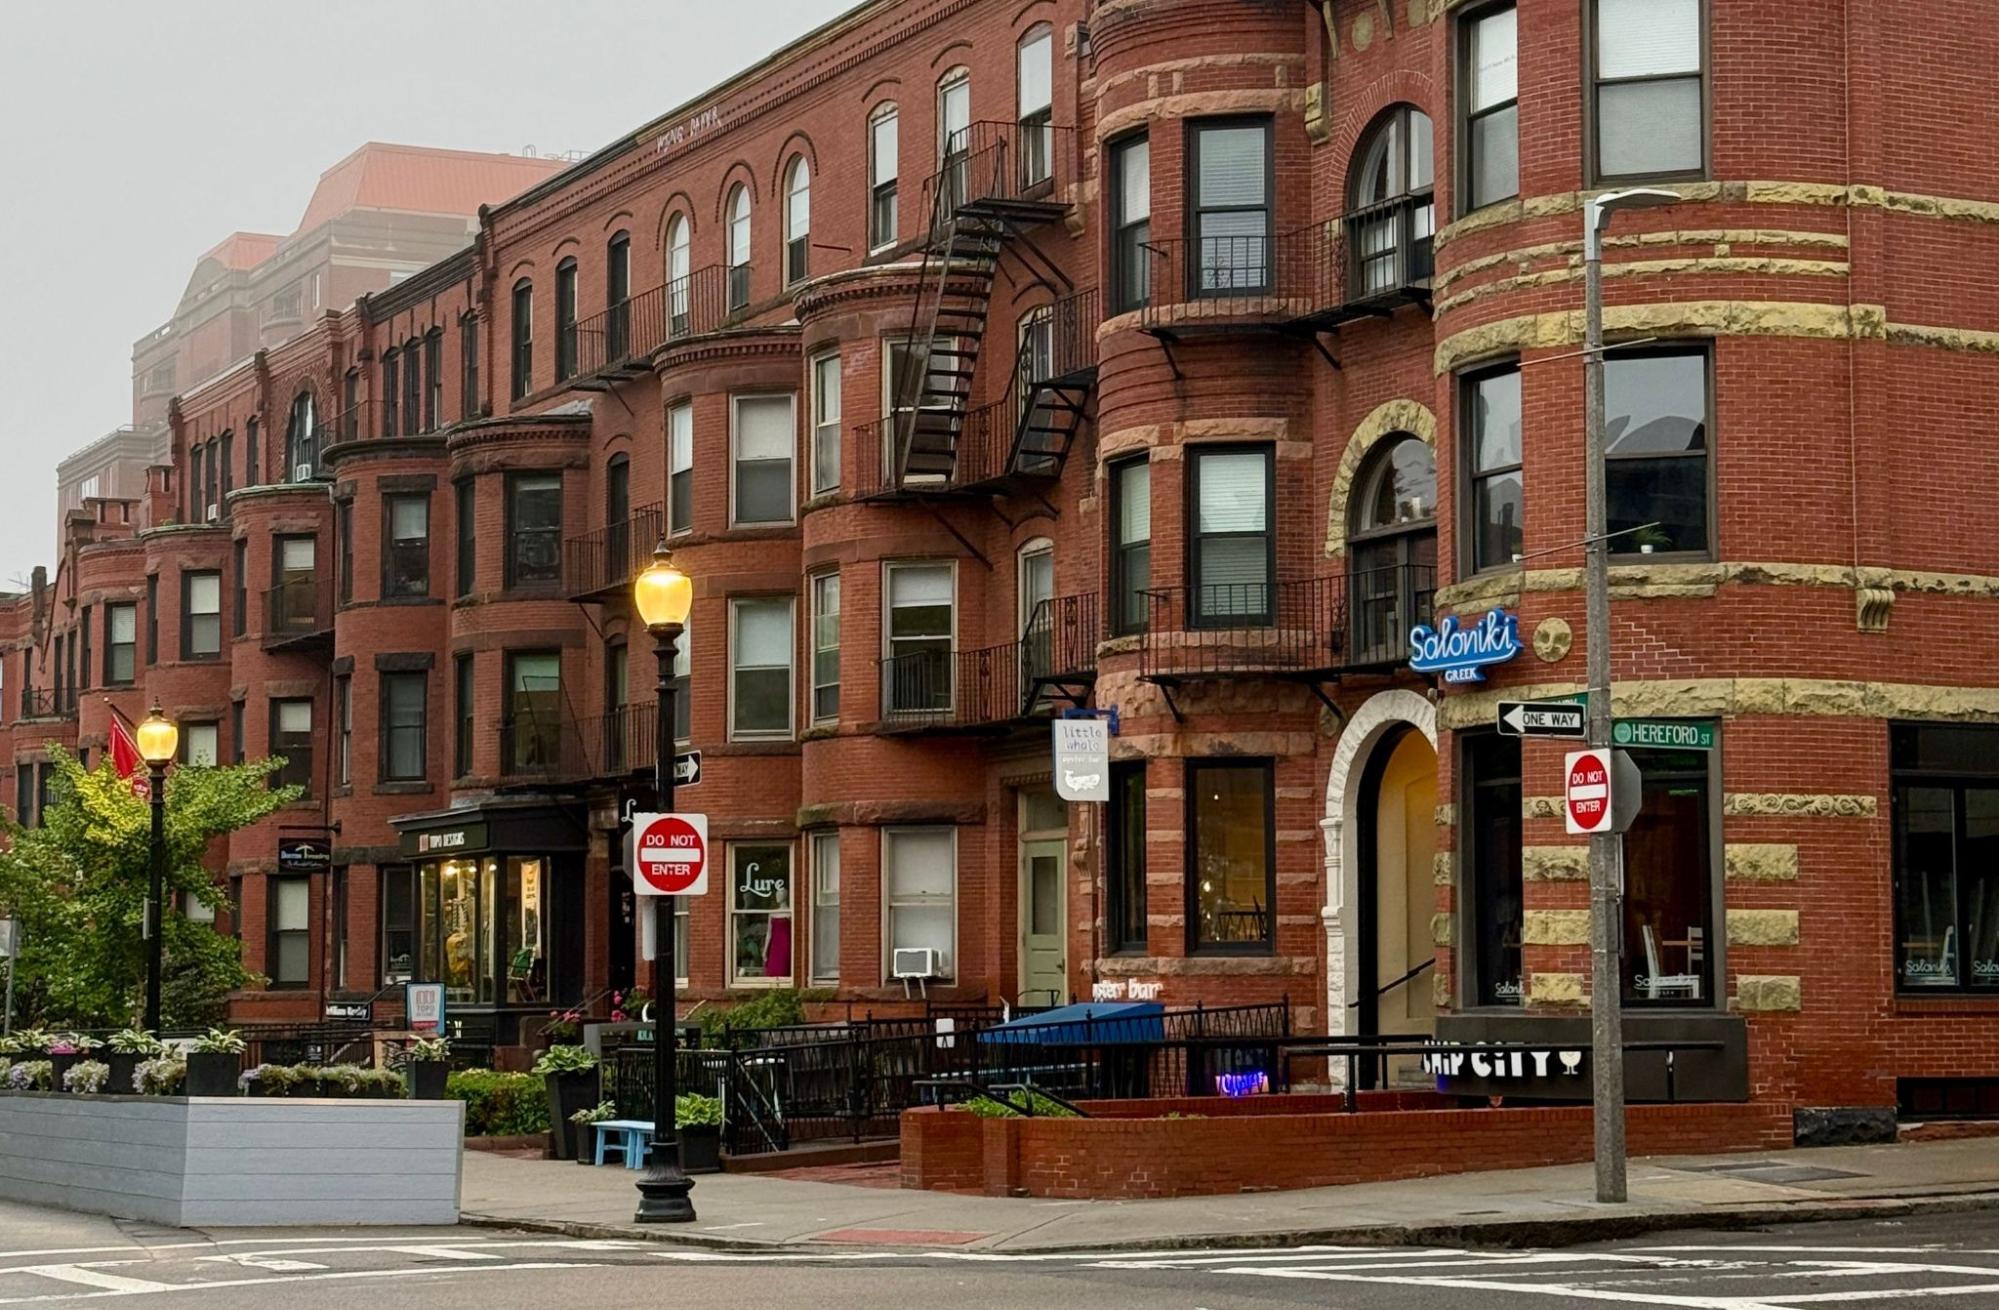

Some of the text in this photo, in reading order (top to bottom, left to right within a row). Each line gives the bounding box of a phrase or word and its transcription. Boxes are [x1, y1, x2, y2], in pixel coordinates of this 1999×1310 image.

[1409, 611, 1514, 662] Saloniki
[1445, 667, 1478, 682] GREEK
[1522, 713, 1576, 726] ONE WAY
[1632, 723, 1698, 745] HEREFORD
[1700, 734, 1711, 745] ST
[1572, 770, 1604, 785] DO NOT
[1576, 801, 1601, 814] ENTER
[646, 834, 696, 846] DO NOT
[651, 864, 691, 876] ENTER
[740, 862, 785, 898] Lure
[1128, 977, 1164, 1000] bar
